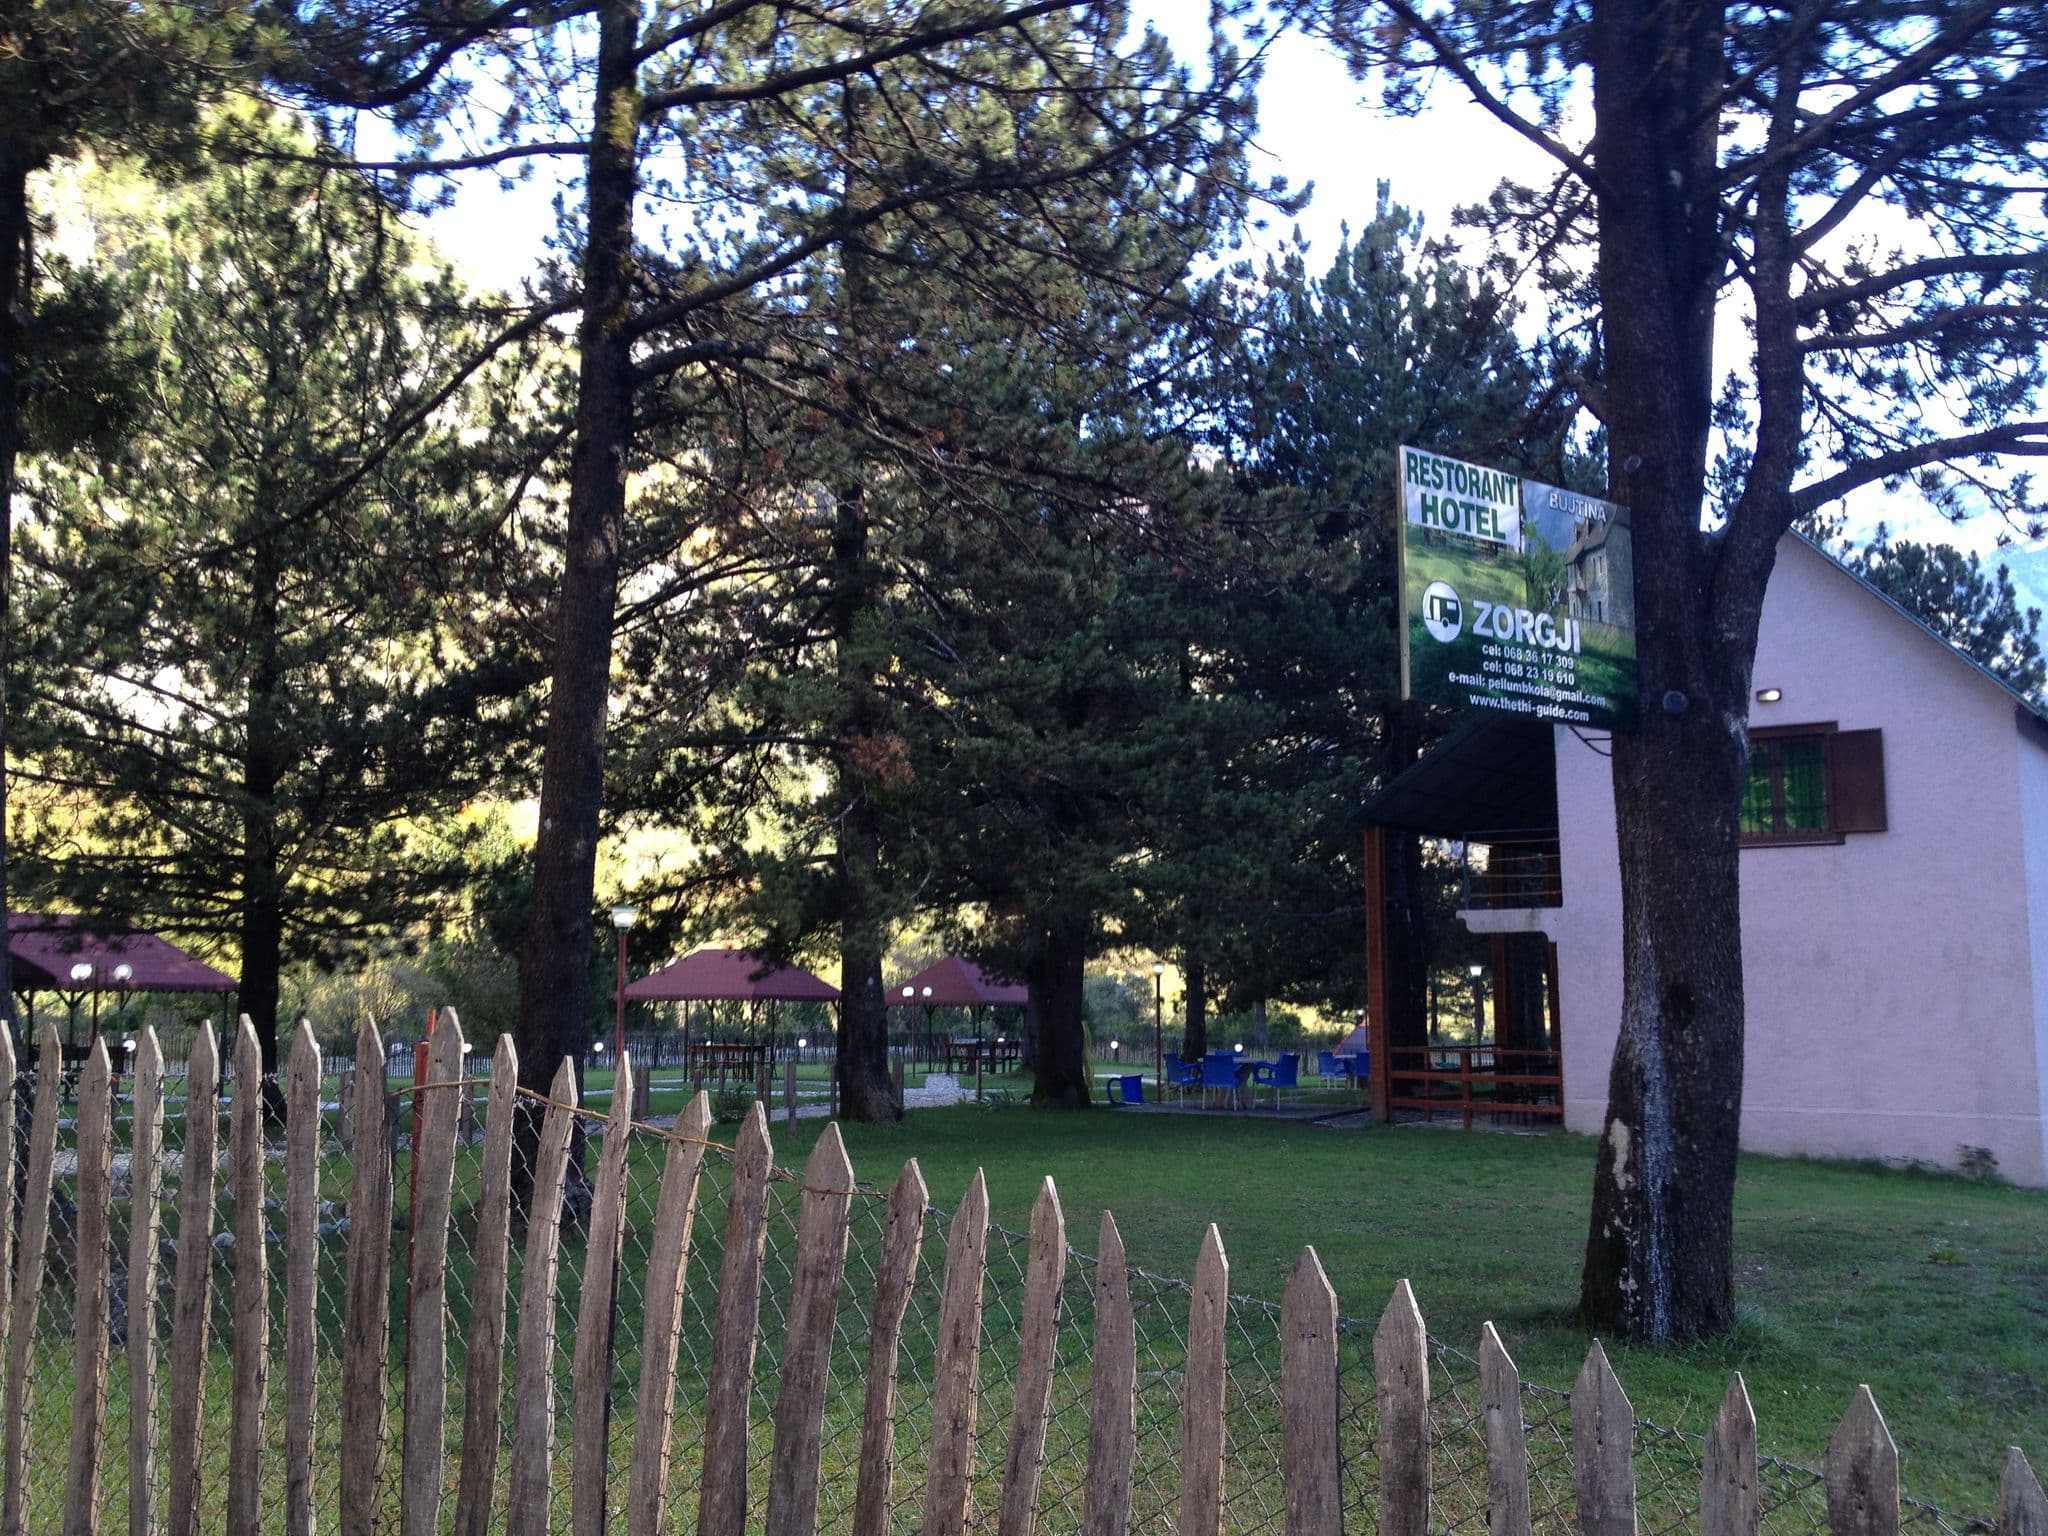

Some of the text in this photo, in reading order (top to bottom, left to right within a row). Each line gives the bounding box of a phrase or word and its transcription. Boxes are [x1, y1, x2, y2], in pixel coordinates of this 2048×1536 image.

[1406, 451, 1516, 506] RESTORANT
[1420, 493, 1506, 540] HOTEL
[1549, 493, 1607, 522] BUJTINA
[1472, 599, 1581, 654] ZORGJI
[1482, 643, 1574, 669] cel: 068 36 17 309
[1448, 670, 1486, 686] e-mail:
[1483, 659, 1575, 685] cel: 068 23 19 610
[1469, 693, 1589, 722] www.thethi-guide.com
